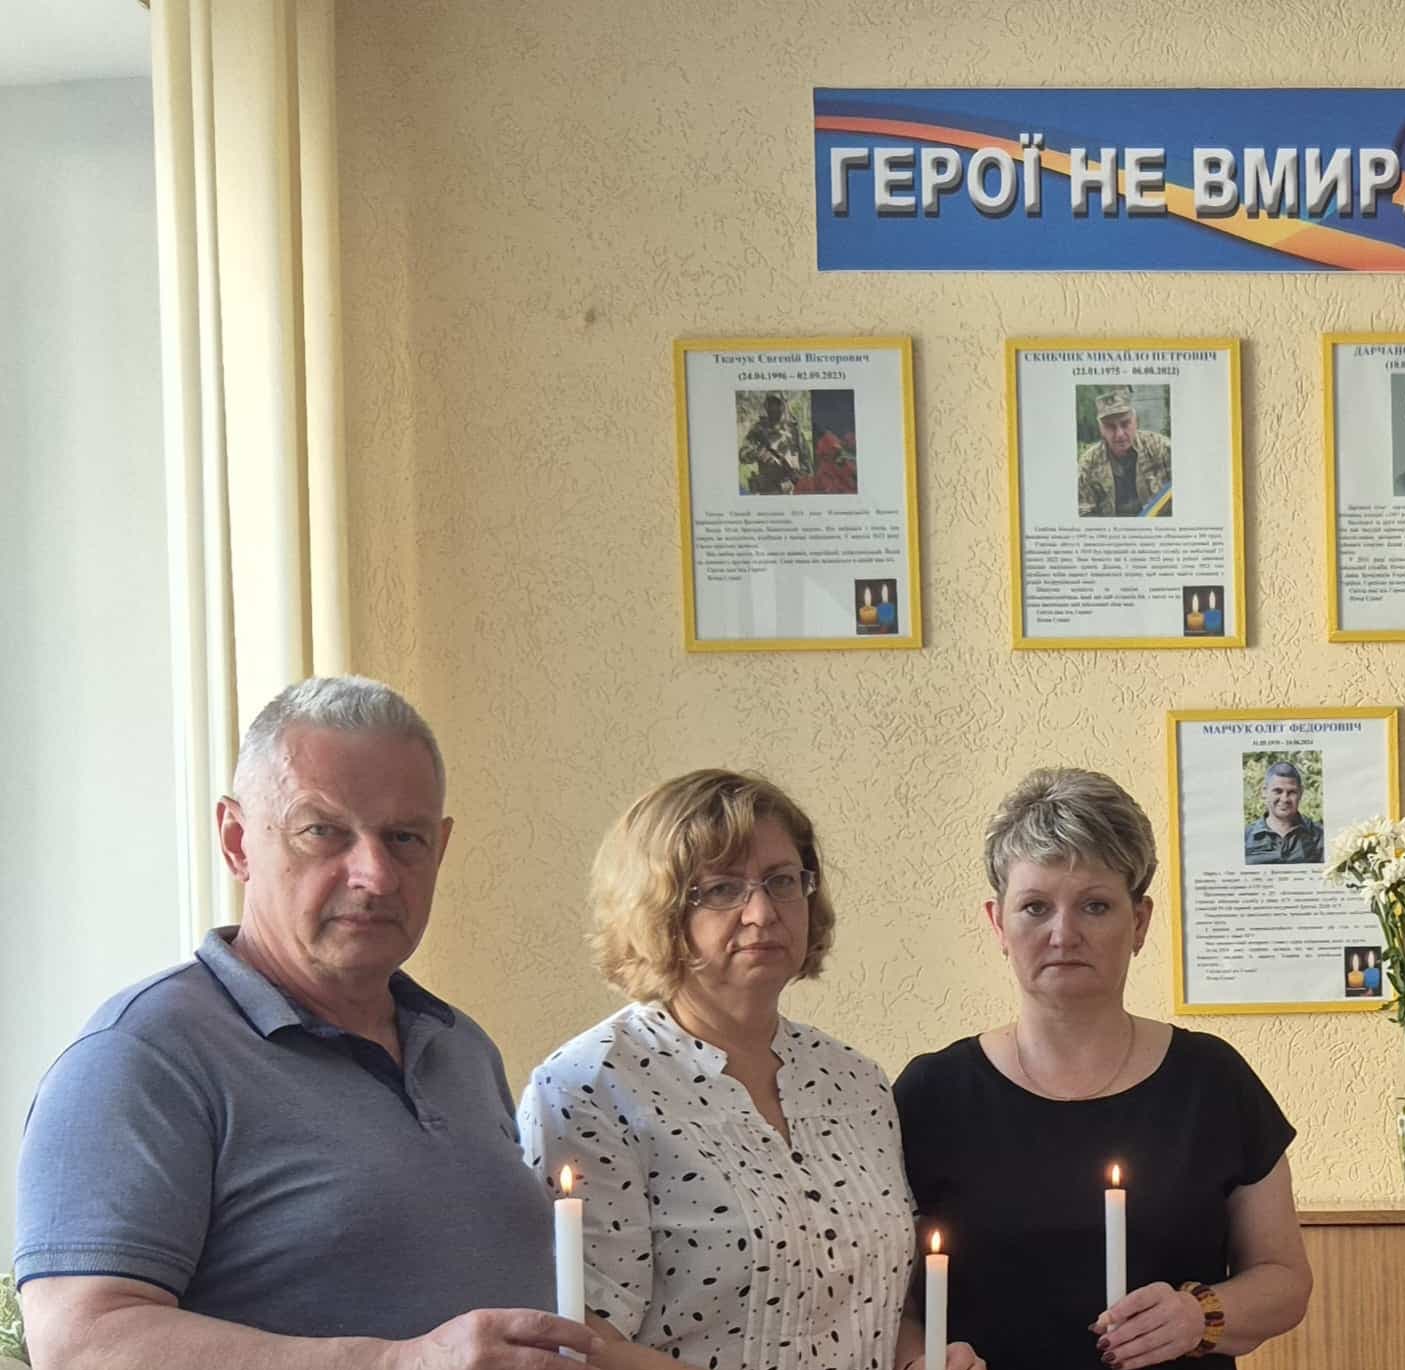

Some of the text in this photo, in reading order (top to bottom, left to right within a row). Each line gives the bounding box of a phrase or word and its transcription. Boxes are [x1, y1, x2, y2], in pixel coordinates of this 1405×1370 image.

[829, 133, 1043, 218] ГЕРОЇ
[1071, 144, 1168, 217] НЕ
[713, 353, 756, 366] Ткачук
[805, 352, 870, 365] Вікторович
[1152, 351, 1217, 361] ПЕТРОВИЧ
[1202, 722, 1362, 735] МАРЧУК ОЛЕГ ФЕДОРОВИЧ
